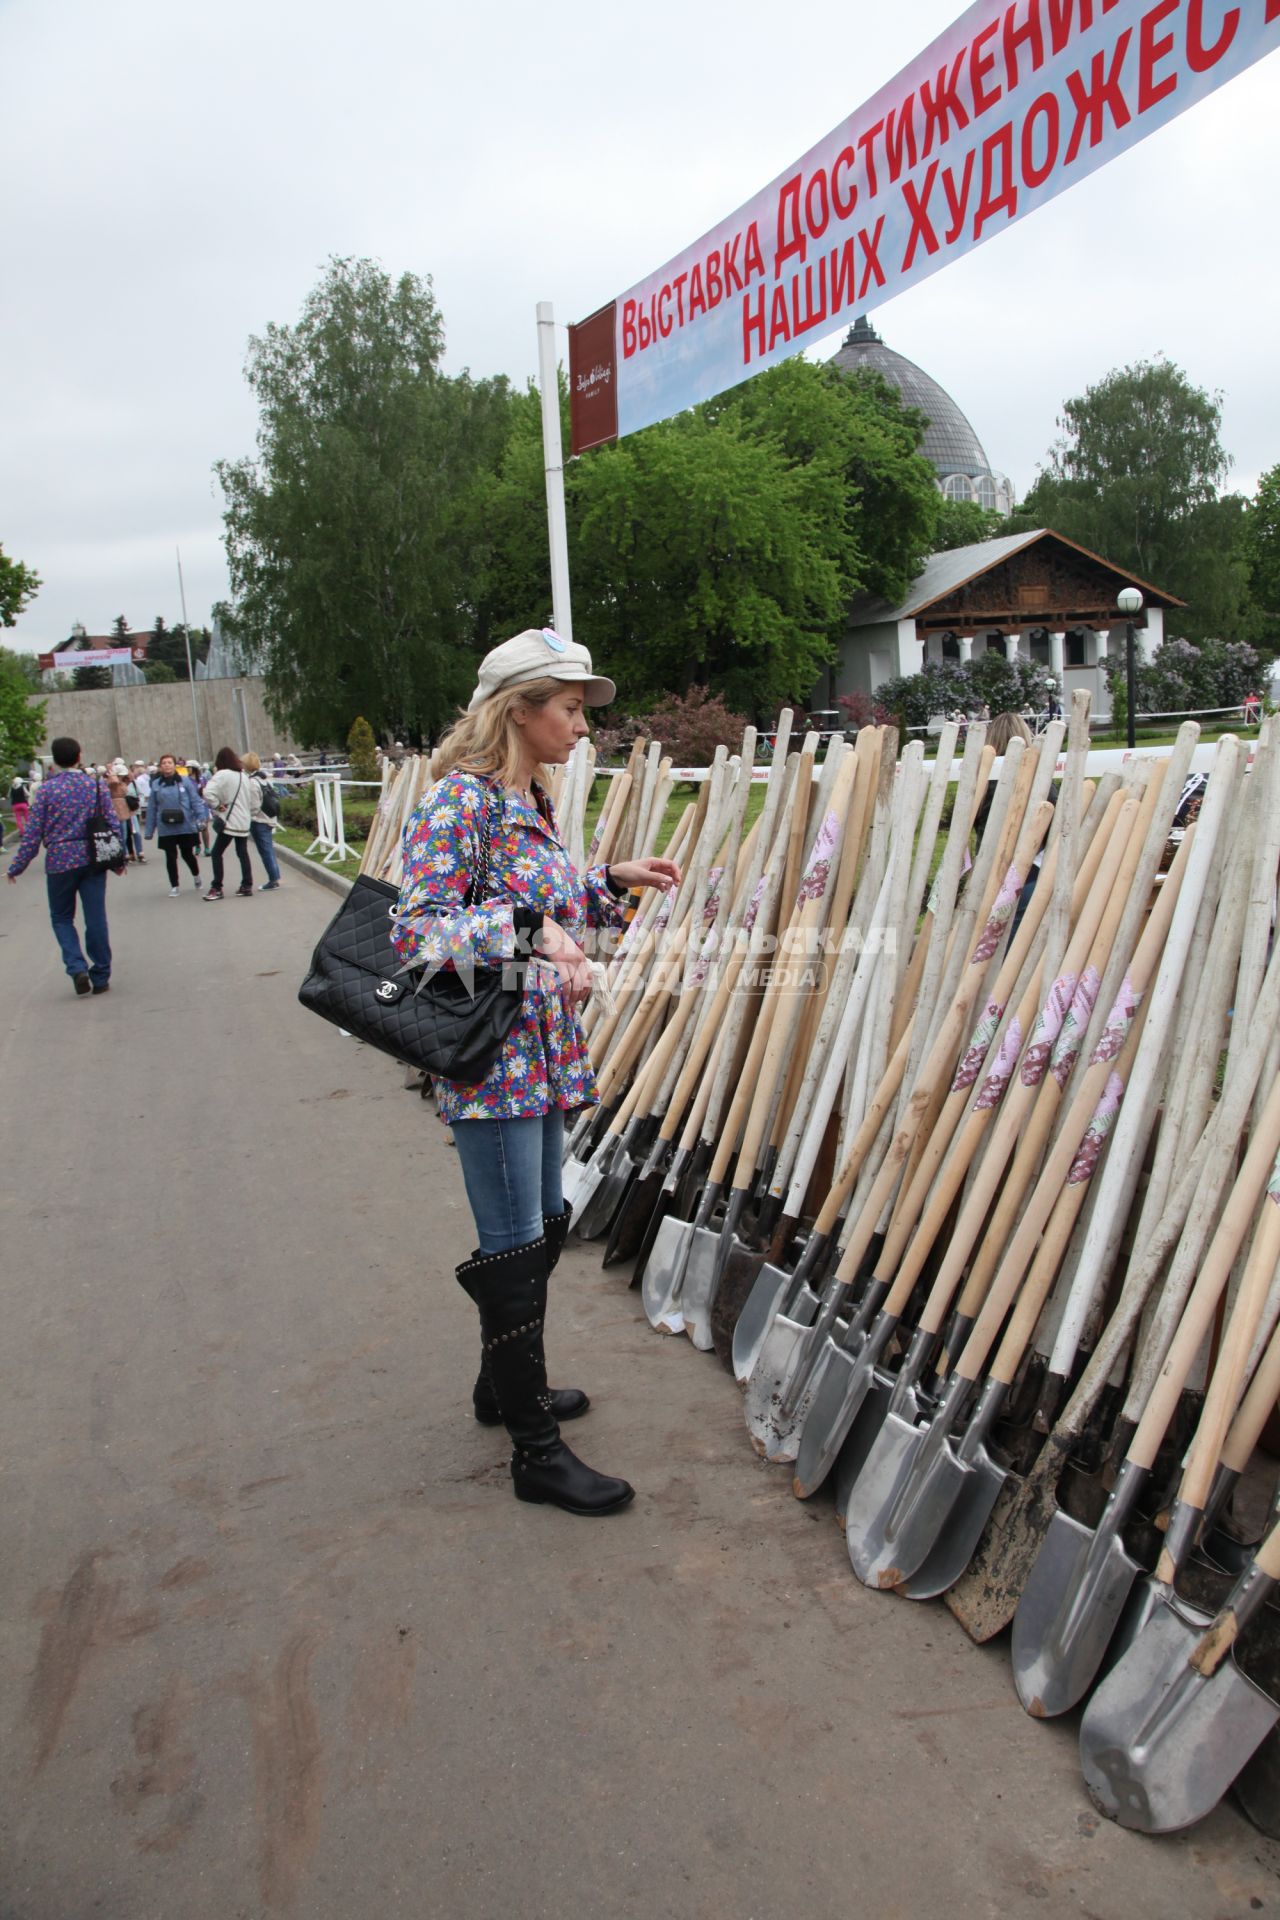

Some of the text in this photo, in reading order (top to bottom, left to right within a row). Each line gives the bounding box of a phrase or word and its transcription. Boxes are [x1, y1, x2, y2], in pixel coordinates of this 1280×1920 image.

[622, 0, 1119, 359] ВЫСТАВКА ДОСТИЖЕНИ
[743, 0, 1280, 363] НАШИХ ХУДОЖЕС
